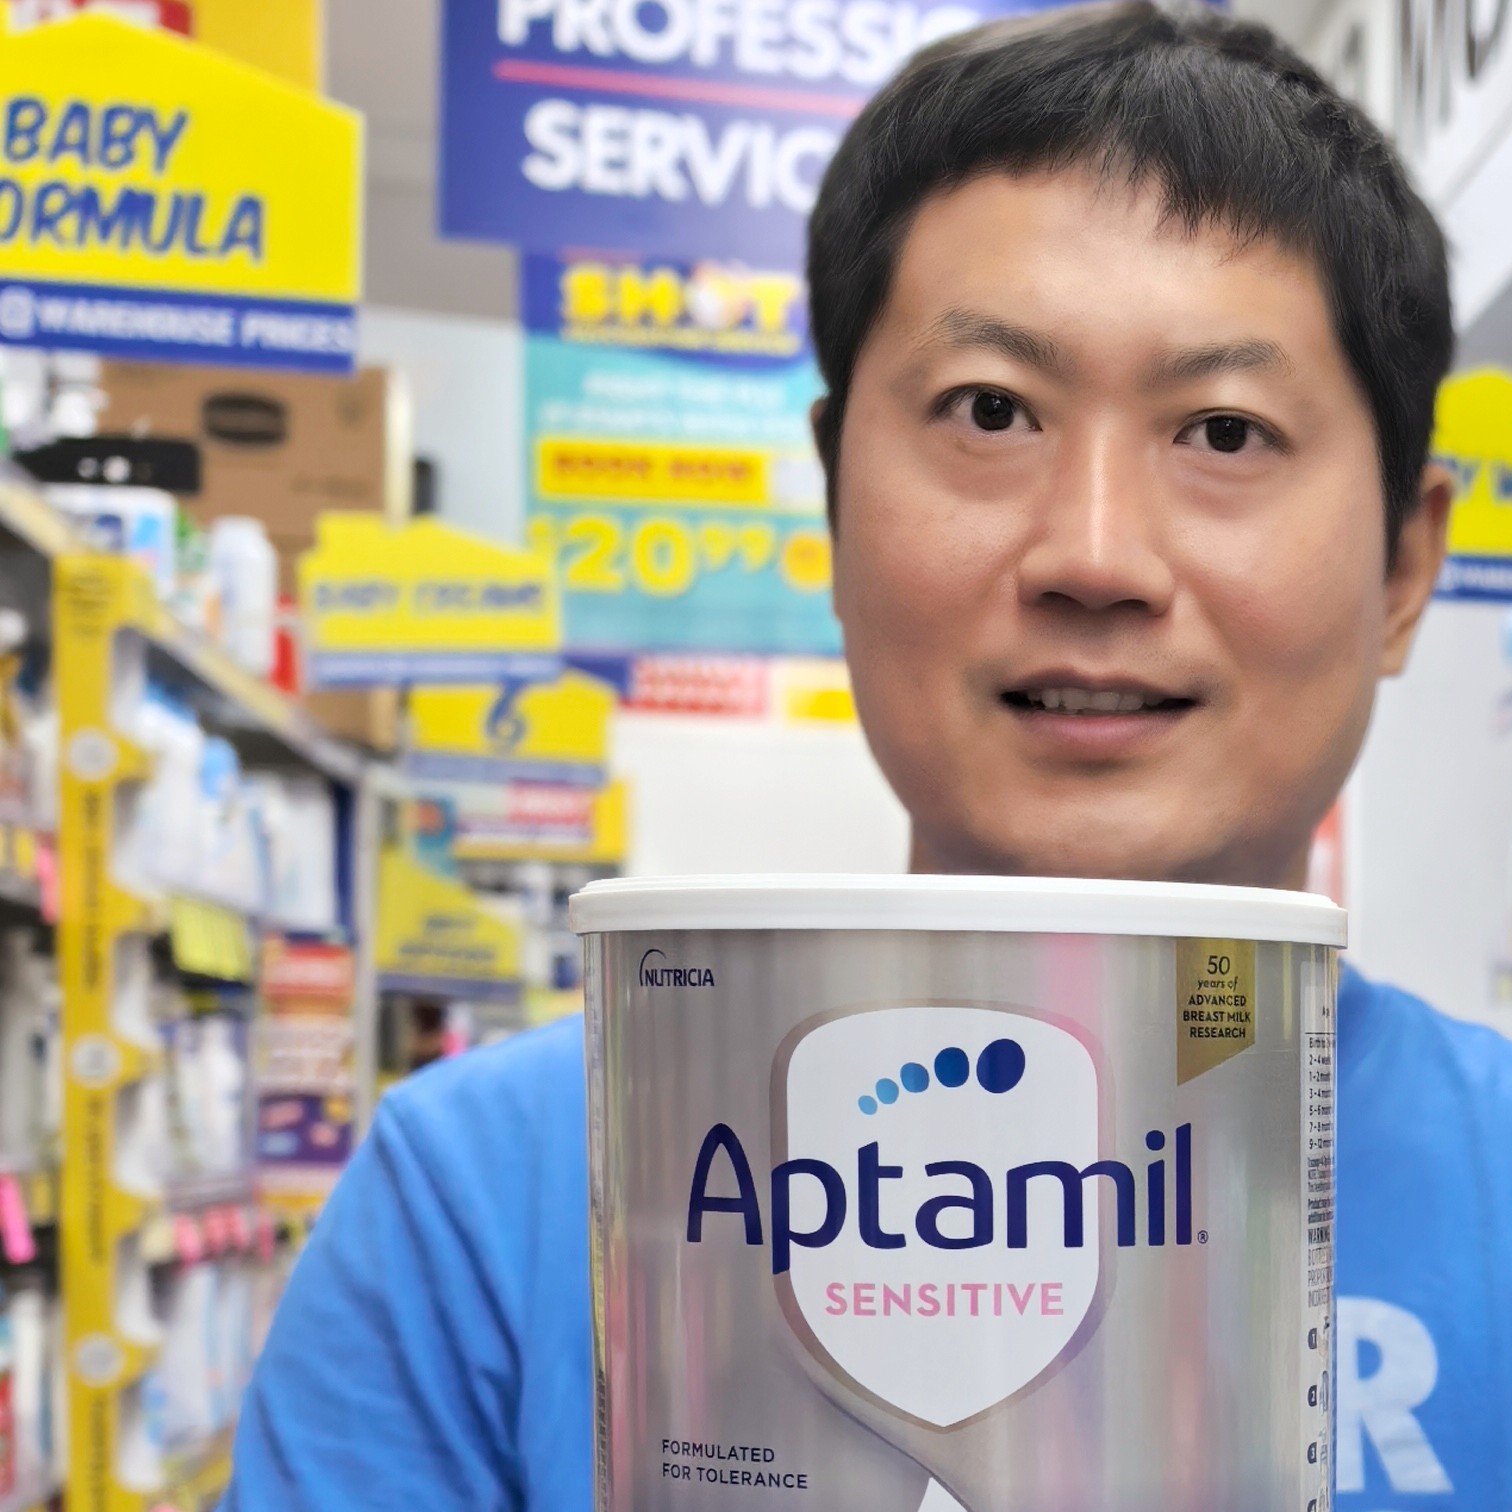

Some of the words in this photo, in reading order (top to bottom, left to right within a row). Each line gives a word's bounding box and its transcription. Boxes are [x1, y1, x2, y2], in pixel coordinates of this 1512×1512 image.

[5, 96, 189, 175] BABY
[522, 98, 850, 212] SERVIC
[0, 178, 264, 265] ORMULA
[40, 294, 236, 347] WAREHOUSE
[644, 968, 715, 987] NUTRICIA
[1207, 955, 1231, 975] 50
[1197, 979, 1225, 991] years
[1228, 976, 1239, 992] of
[1188, 995, 1247, 1007] ADVANCED
[1183, 1011, 1225, 1022] BREAST
[1227, 1011, 1251, 1023] MILK
[1190, 1027, 1246, 1038] RESEARCH
[686, 1122, 1192, 1275] Aptamil
[824, 1282, 1064, 1318] SENSITIVE
[662, 1439, 775, 1463] FORMULATED
[662, 1463, 692, 1480] FOR
[697, 1467, 808, 1489] TOLERANCE
